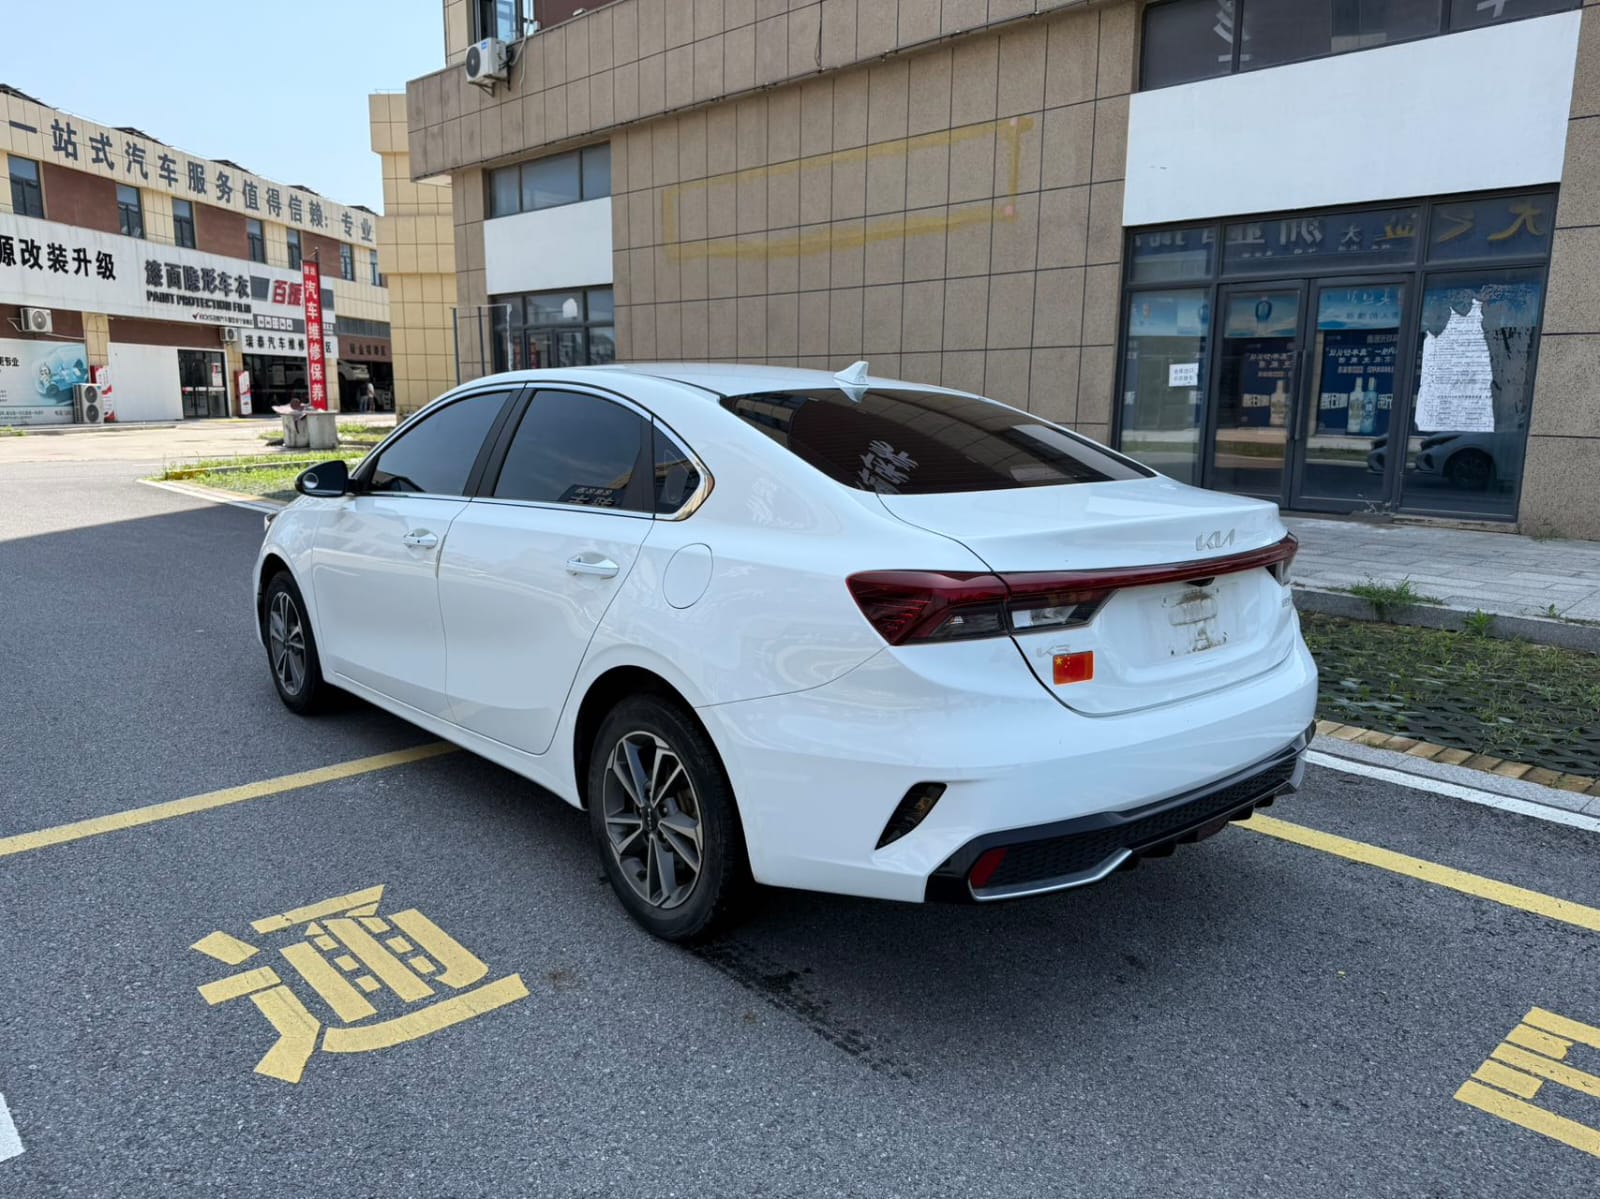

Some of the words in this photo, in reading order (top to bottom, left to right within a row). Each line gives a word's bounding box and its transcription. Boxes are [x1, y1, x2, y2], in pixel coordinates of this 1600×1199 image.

[145, 259, 250, 298] 漆面隐形车衣
[146, 290, 175, 304] PAINT
[176, 294, 232, 311] PROTECTION
[233, 302, 252, 313] FILM
[304, 280, 325, 401] 汽车维修保养
[1195, 527, 1236, 551] KIA
